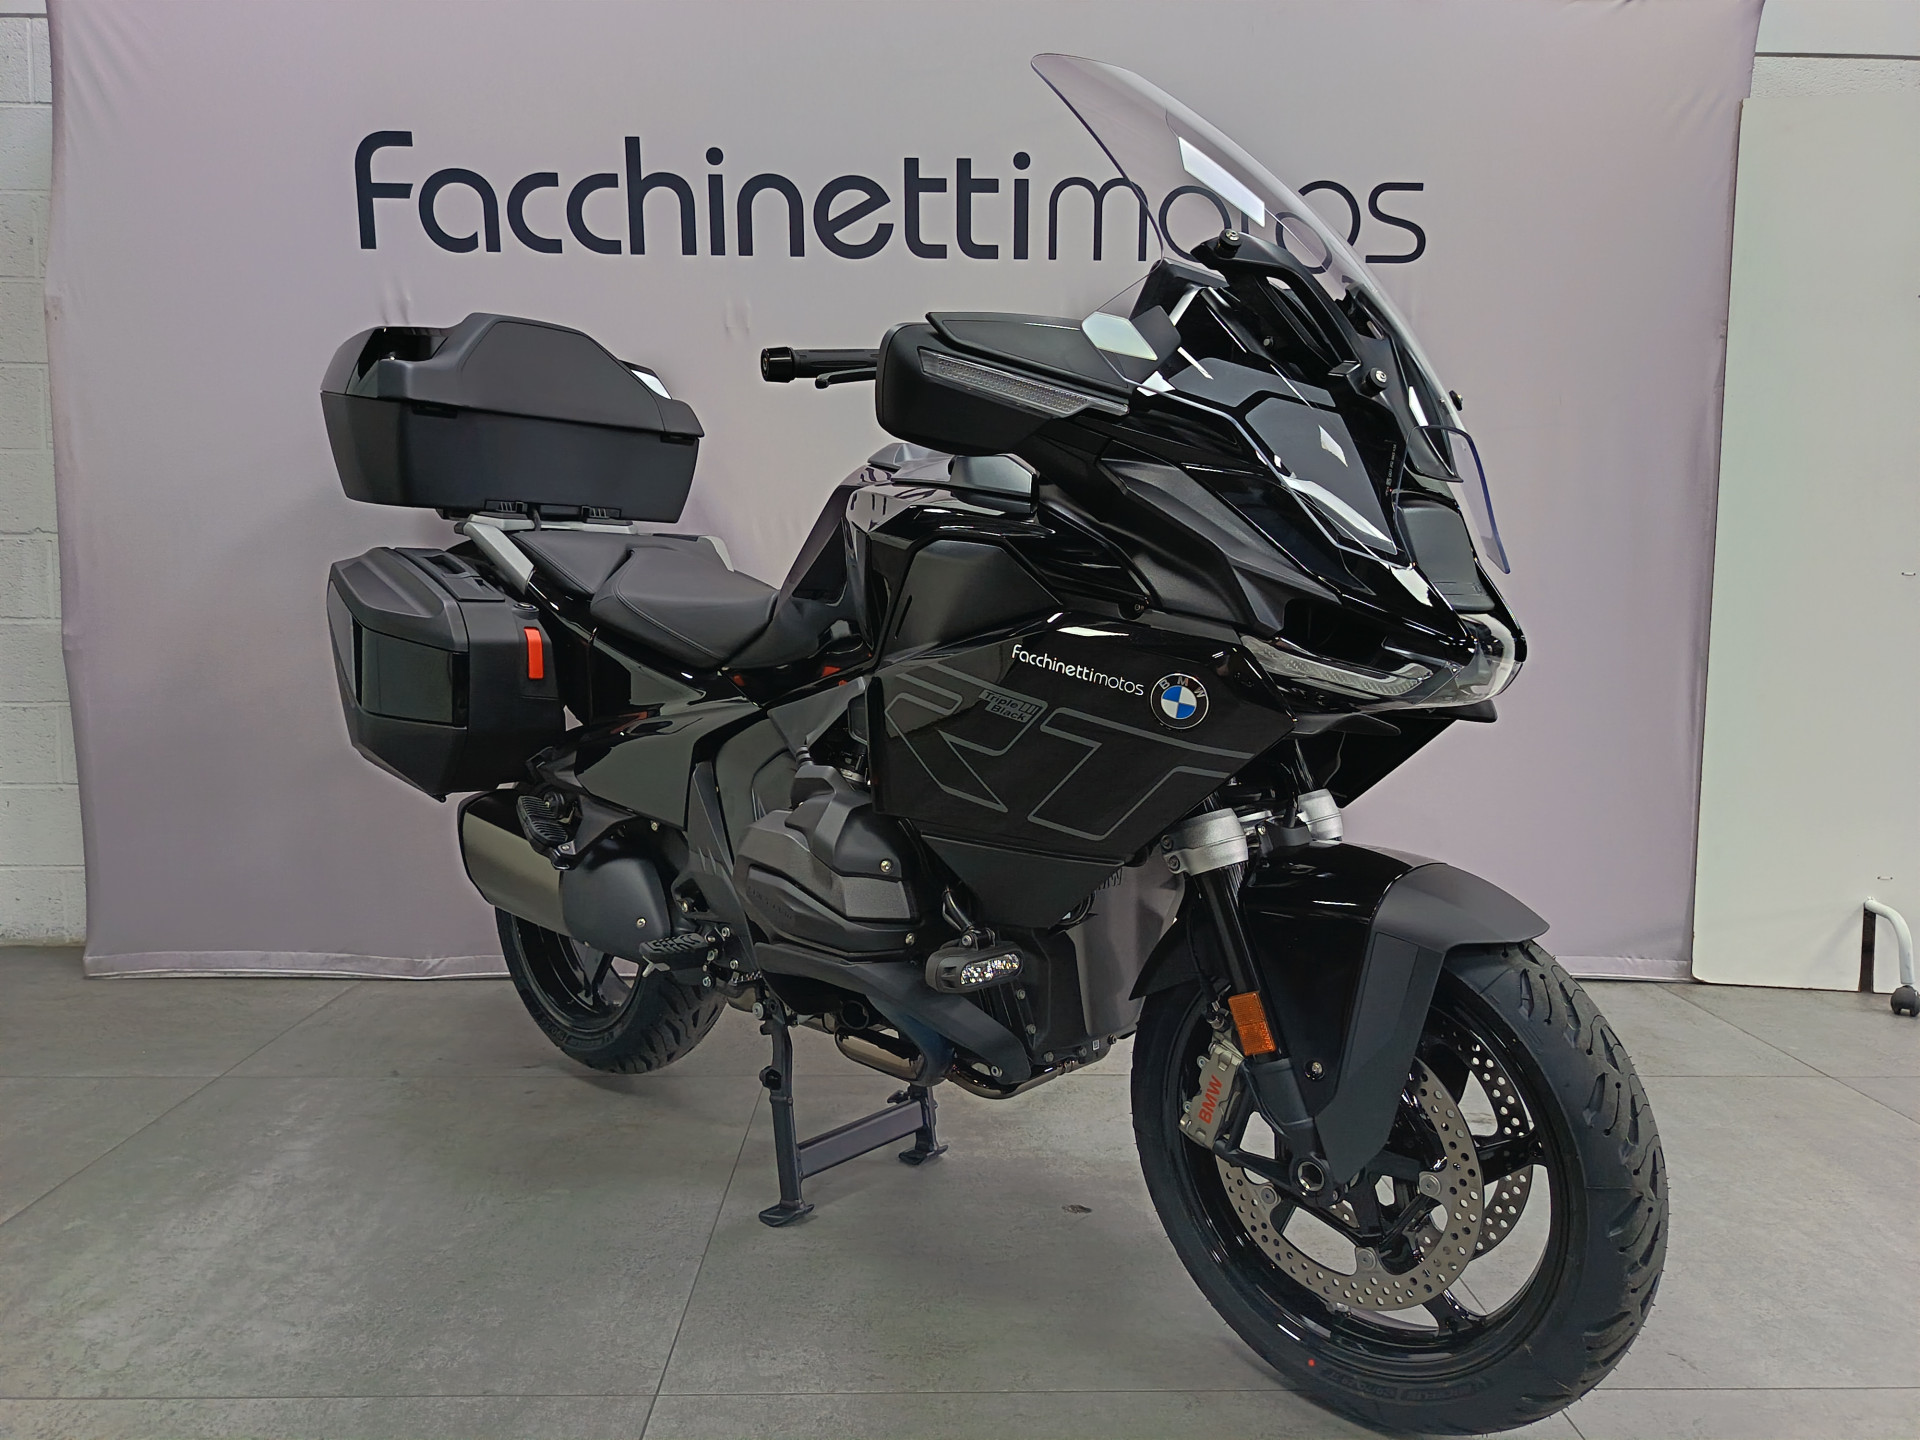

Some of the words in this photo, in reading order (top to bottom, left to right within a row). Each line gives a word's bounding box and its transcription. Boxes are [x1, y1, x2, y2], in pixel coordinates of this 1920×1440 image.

[1158, 676, 1206, 698] BMW
[984, 691, 1019, 709] Triple
[990, 704, 1027, 721] Black
[1198, 1074, 1223, 1125] BMW
